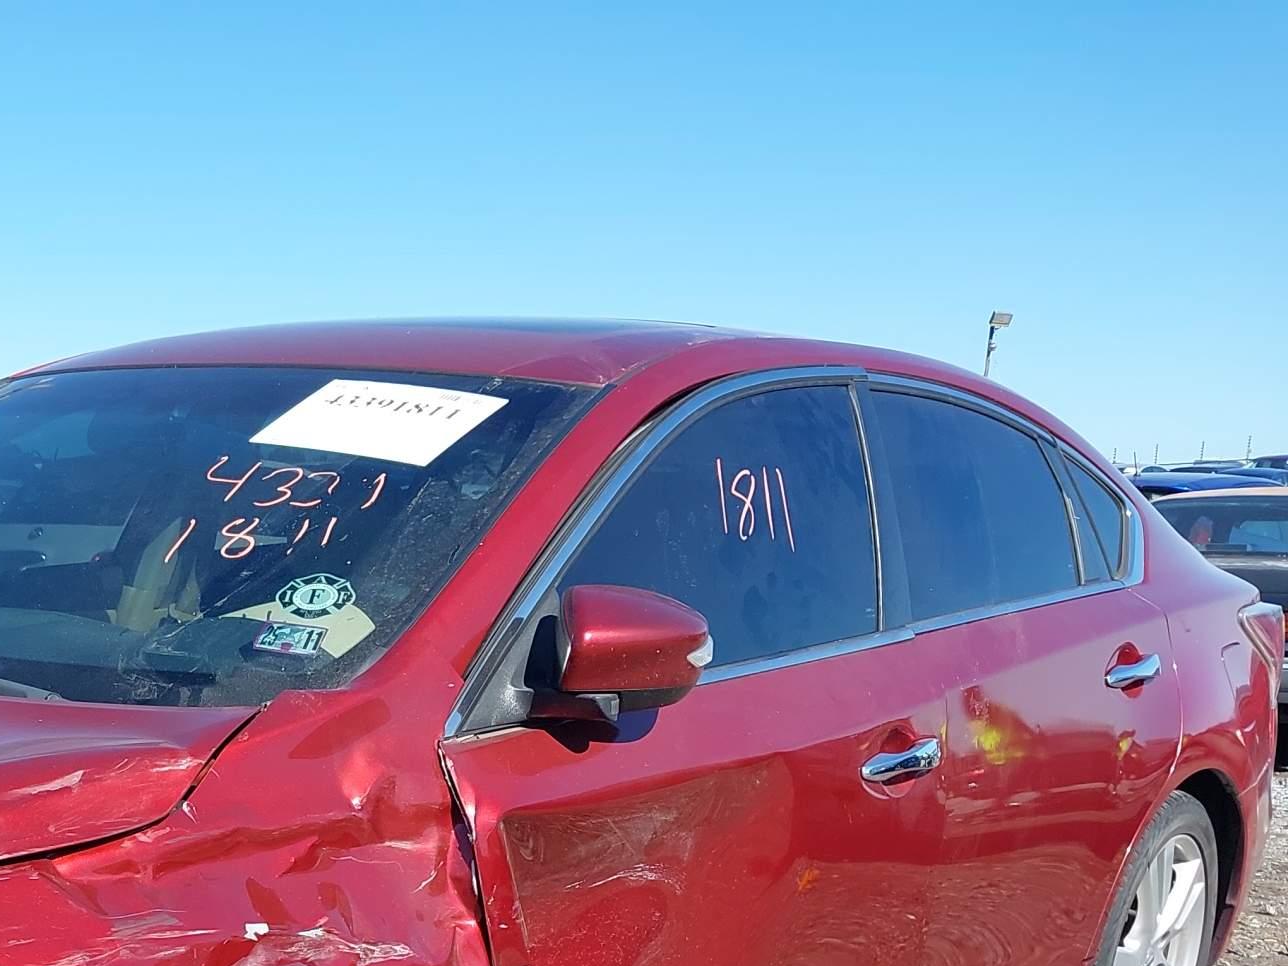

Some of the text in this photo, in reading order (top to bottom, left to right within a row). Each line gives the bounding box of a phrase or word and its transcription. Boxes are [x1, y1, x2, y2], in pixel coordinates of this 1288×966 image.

[716, 458, 795, 552] 1811
[164, 517, 338, 563] 1811
[302, 629, 323, 650] 11
